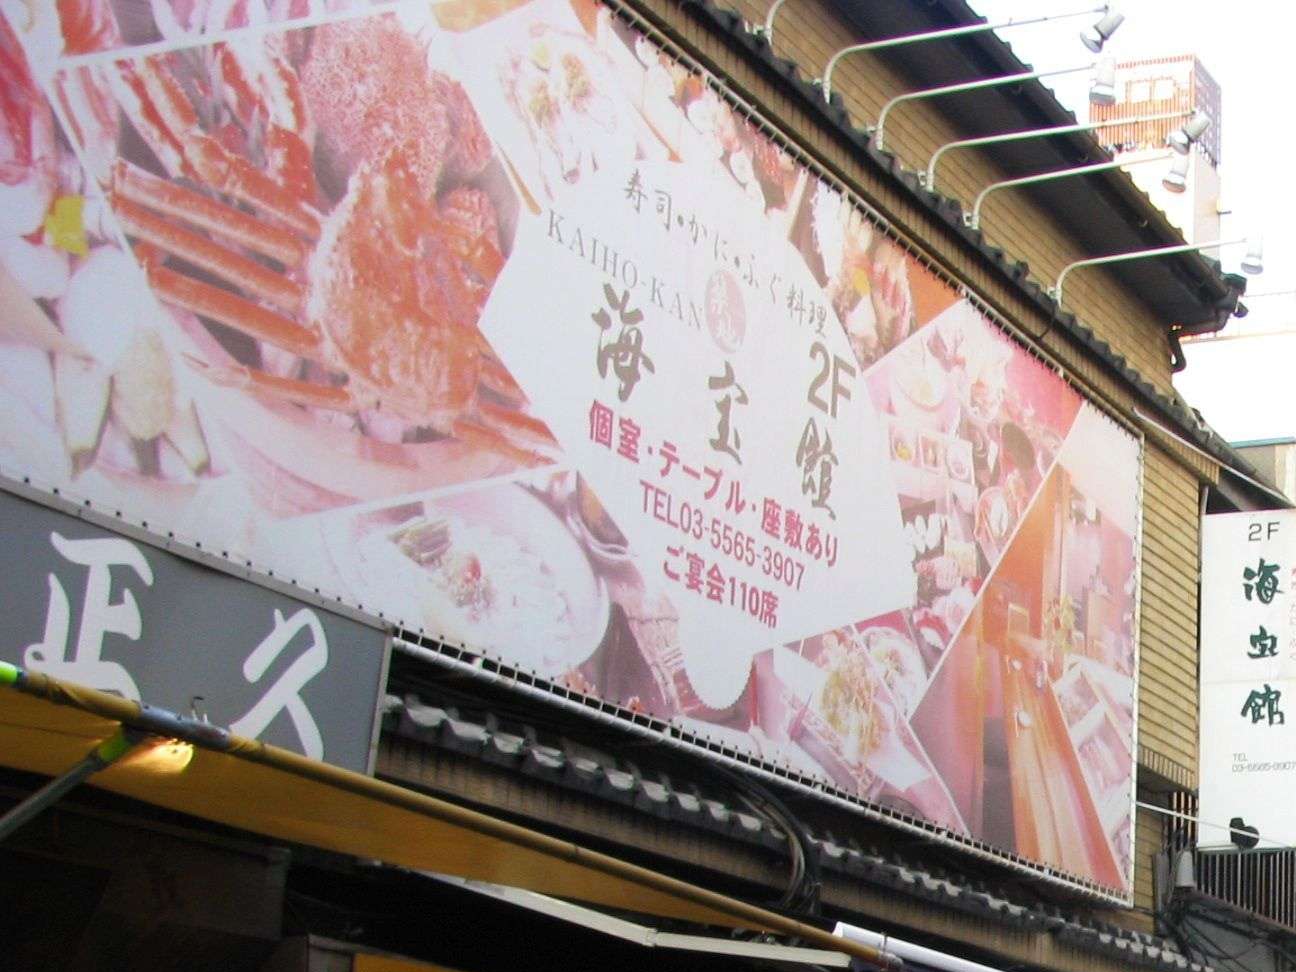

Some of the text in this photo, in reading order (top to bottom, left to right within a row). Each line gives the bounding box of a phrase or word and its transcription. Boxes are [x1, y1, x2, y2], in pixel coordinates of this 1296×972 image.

[548, 208, 702, 330] KAIHO-KAN
[807, 341, 857, 420] 2F
[588, 400, 839, 568] 個室・テーブル・座敷あり
[1248, 522, 1281, 542] 2F
[663, 545, 780, 629] ご宴会110席
